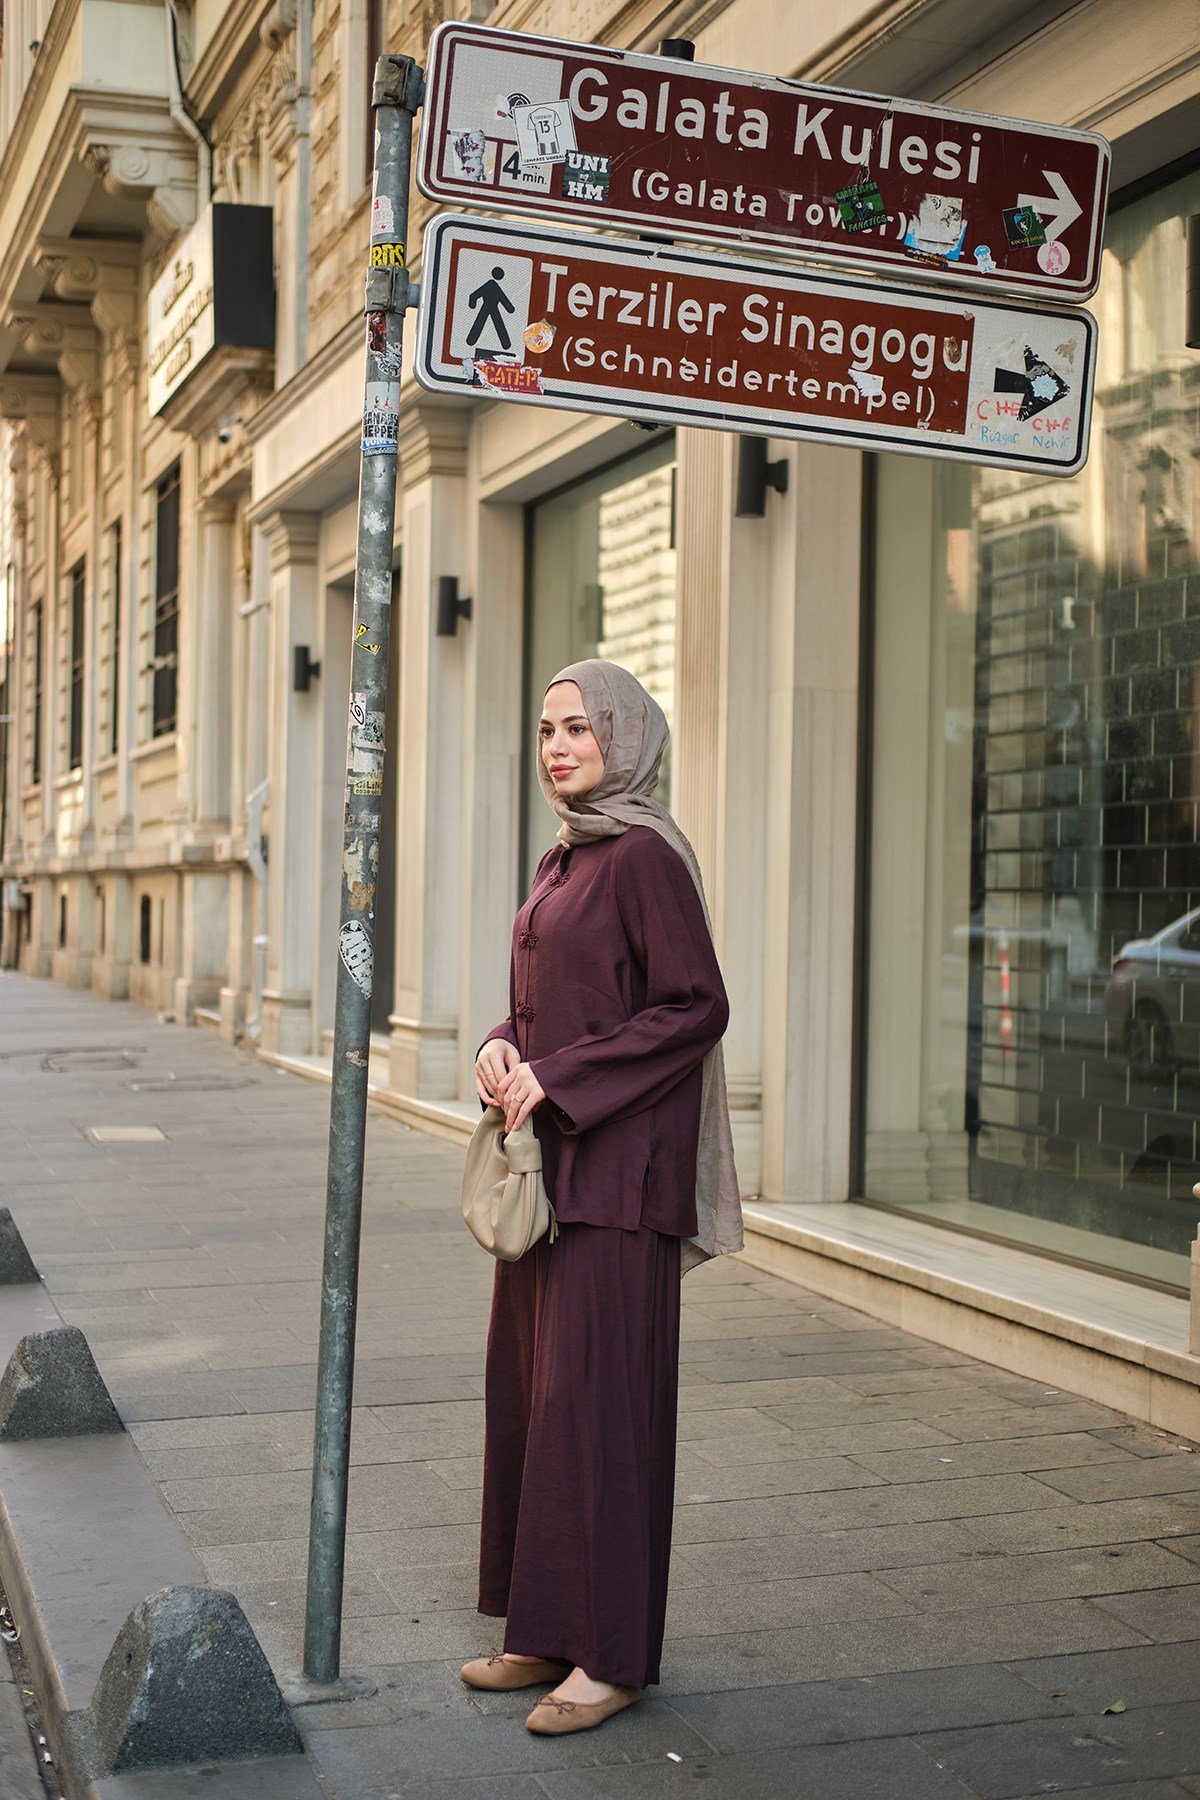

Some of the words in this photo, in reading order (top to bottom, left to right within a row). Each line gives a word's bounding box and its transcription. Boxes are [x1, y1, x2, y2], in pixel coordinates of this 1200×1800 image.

[538, 120, 551, 133] 13
[568, 67, 769, 150] Galata
[794, 103, 982, 184] Kulesi
[502, 151, 521, 180] 4
[522, 172, 547, 185] min.
[568, 153, 608, 173] UNI
[567, 181, 604, 201] HM
[632, 168, 768, 218] (Galata
[848, 215, 888, 232] FANATICS
[540, 262, 727, 336] Terziler
[741, 294, 969, 380] Sinagogu
[562, 336, 935, 421] (Schneidertempel)
